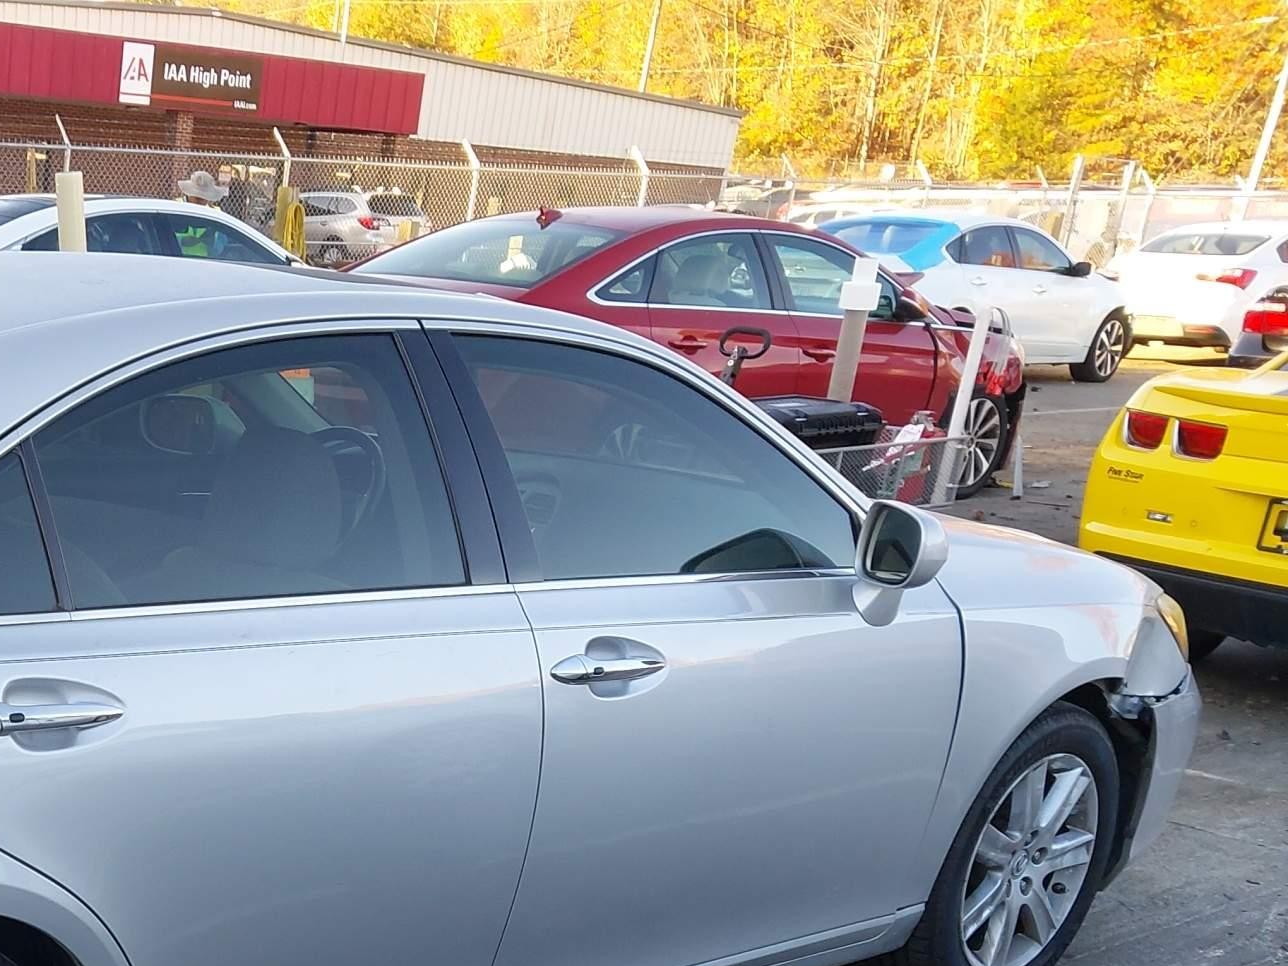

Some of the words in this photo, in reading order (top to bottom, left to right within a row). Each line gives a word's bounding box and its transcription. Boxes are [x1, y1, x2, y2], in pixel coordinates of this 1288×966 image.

[163, 62, 187, 82] IAA
[190, 65, 218, 89] High
[220, 68, 252, 89] Point
